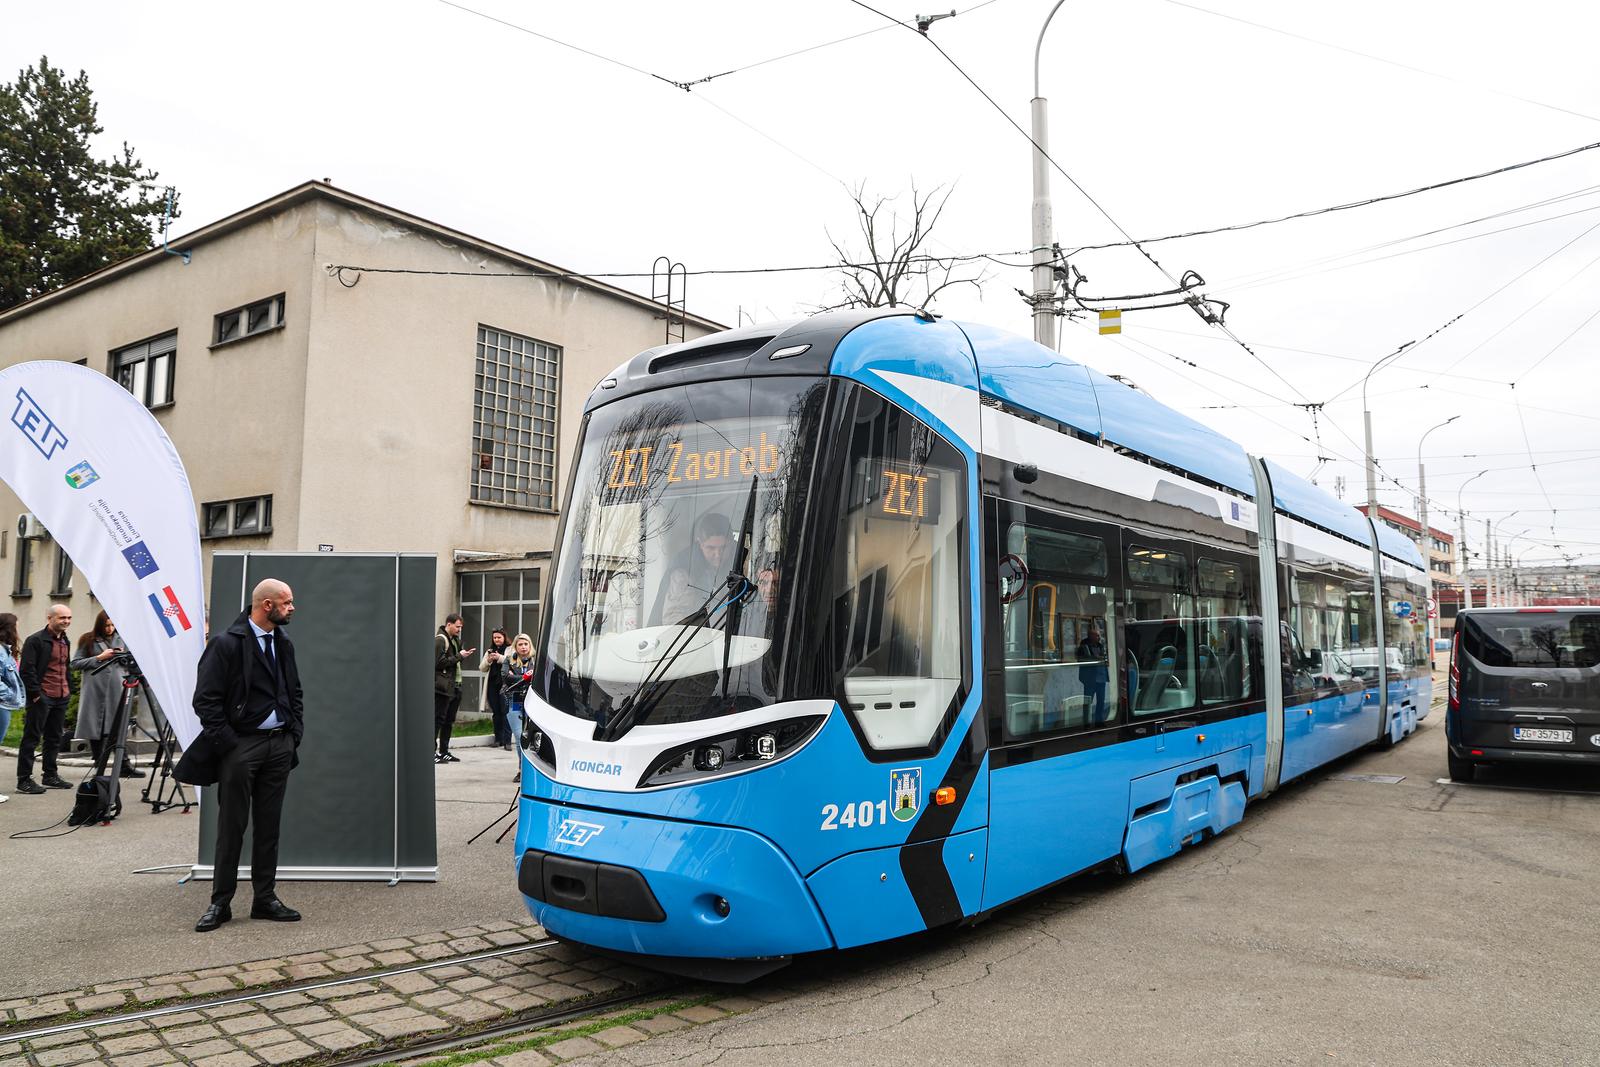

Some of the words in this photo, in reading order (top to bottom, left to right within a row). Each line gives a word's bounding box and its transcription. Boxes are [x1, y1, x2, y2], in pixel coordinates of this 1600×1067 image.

[608, 446, 654, 489] ZET
[667, 432, 779, 483] Zagreb
[882, 471, 929, 517] ZET
[1521, 729, 1532, 738] ZG
[820, 799, 887, 831] 2401
[555, 819, 605, 847] ZET
